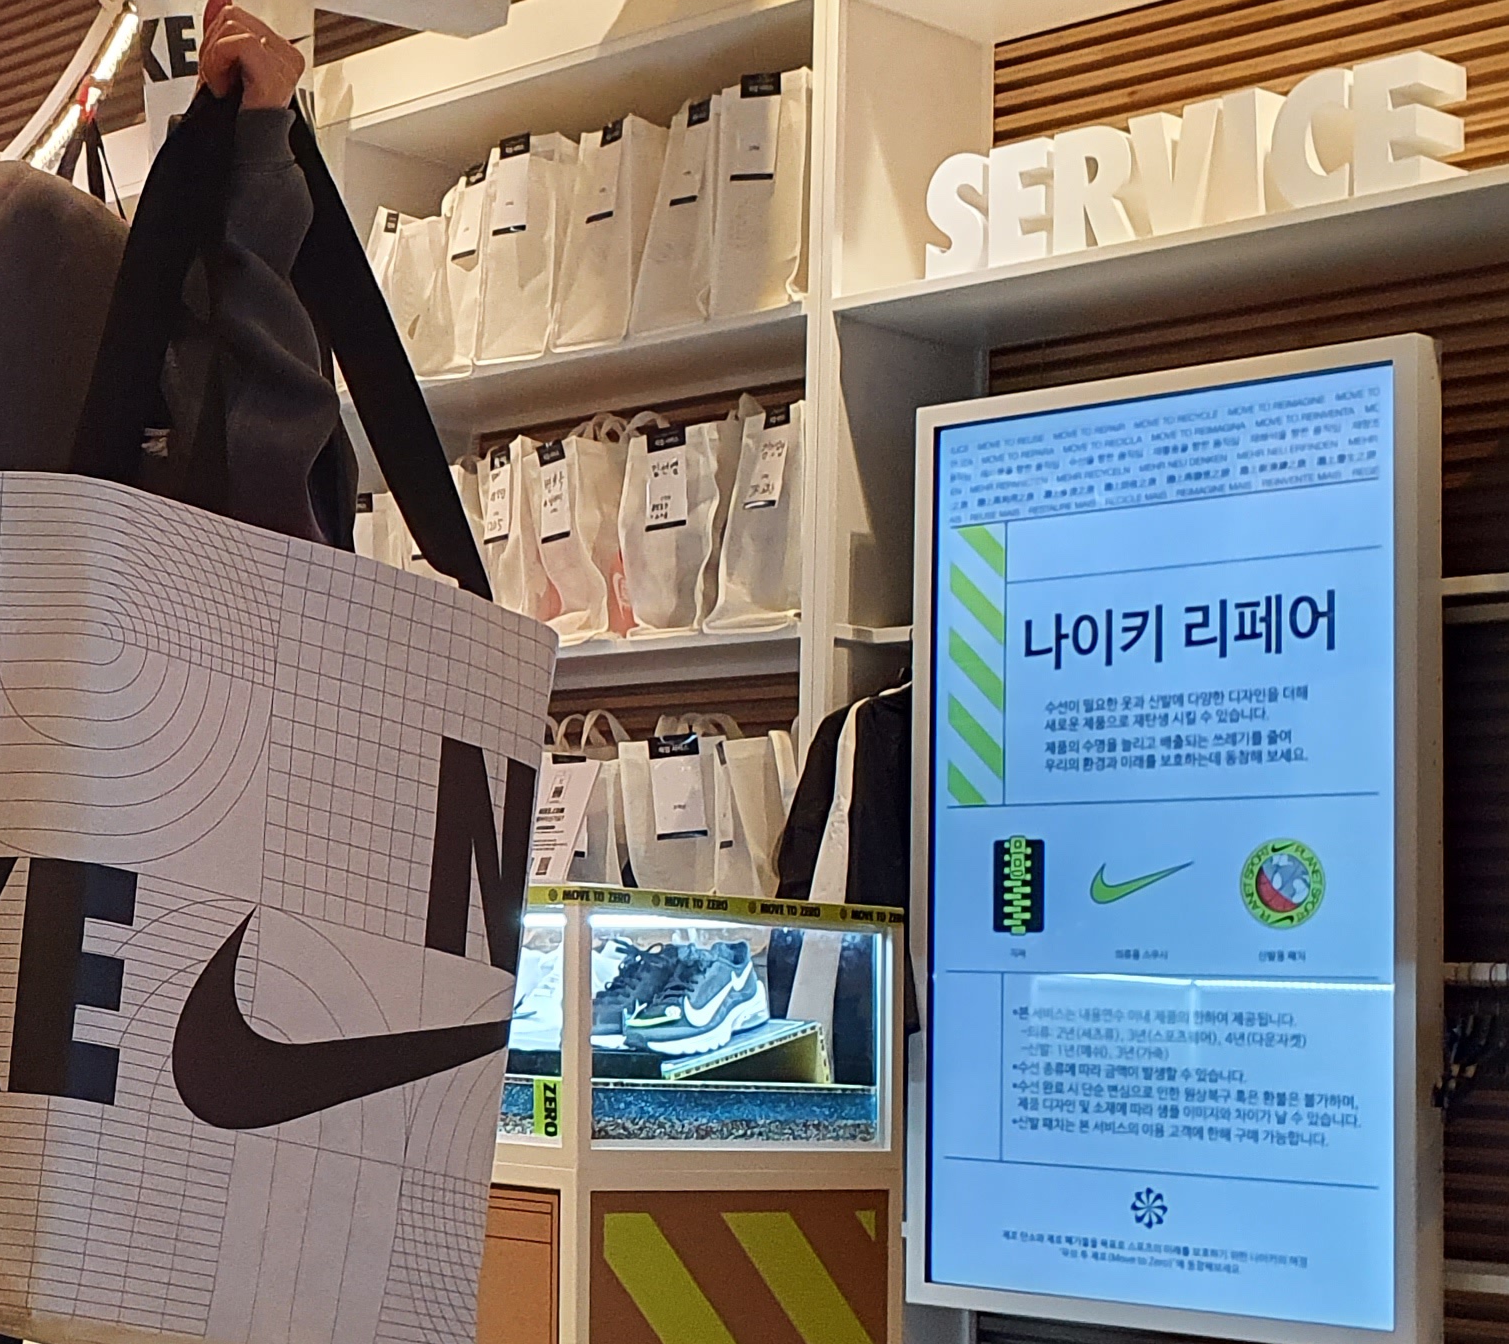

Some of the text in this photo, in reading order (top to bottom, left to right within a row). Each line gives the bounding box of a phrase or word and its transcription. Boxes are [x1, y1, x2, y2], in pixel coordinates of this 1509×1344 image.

[926, 50, 1469, 279] SERVICE
[1024, 589, 1335, 670] 나이키 리페어
[562, 889, 631, 904] MOVE TO ZERO
[664, 896, 728, 911] MOVE TO ZERO
[760, 903, 821, 917] MOVE TO ZERO
[851, 909, 874, 922] MOVE
[876, 911, 886, 922] TO
[543, 1082, 558, 1137] ZERO
